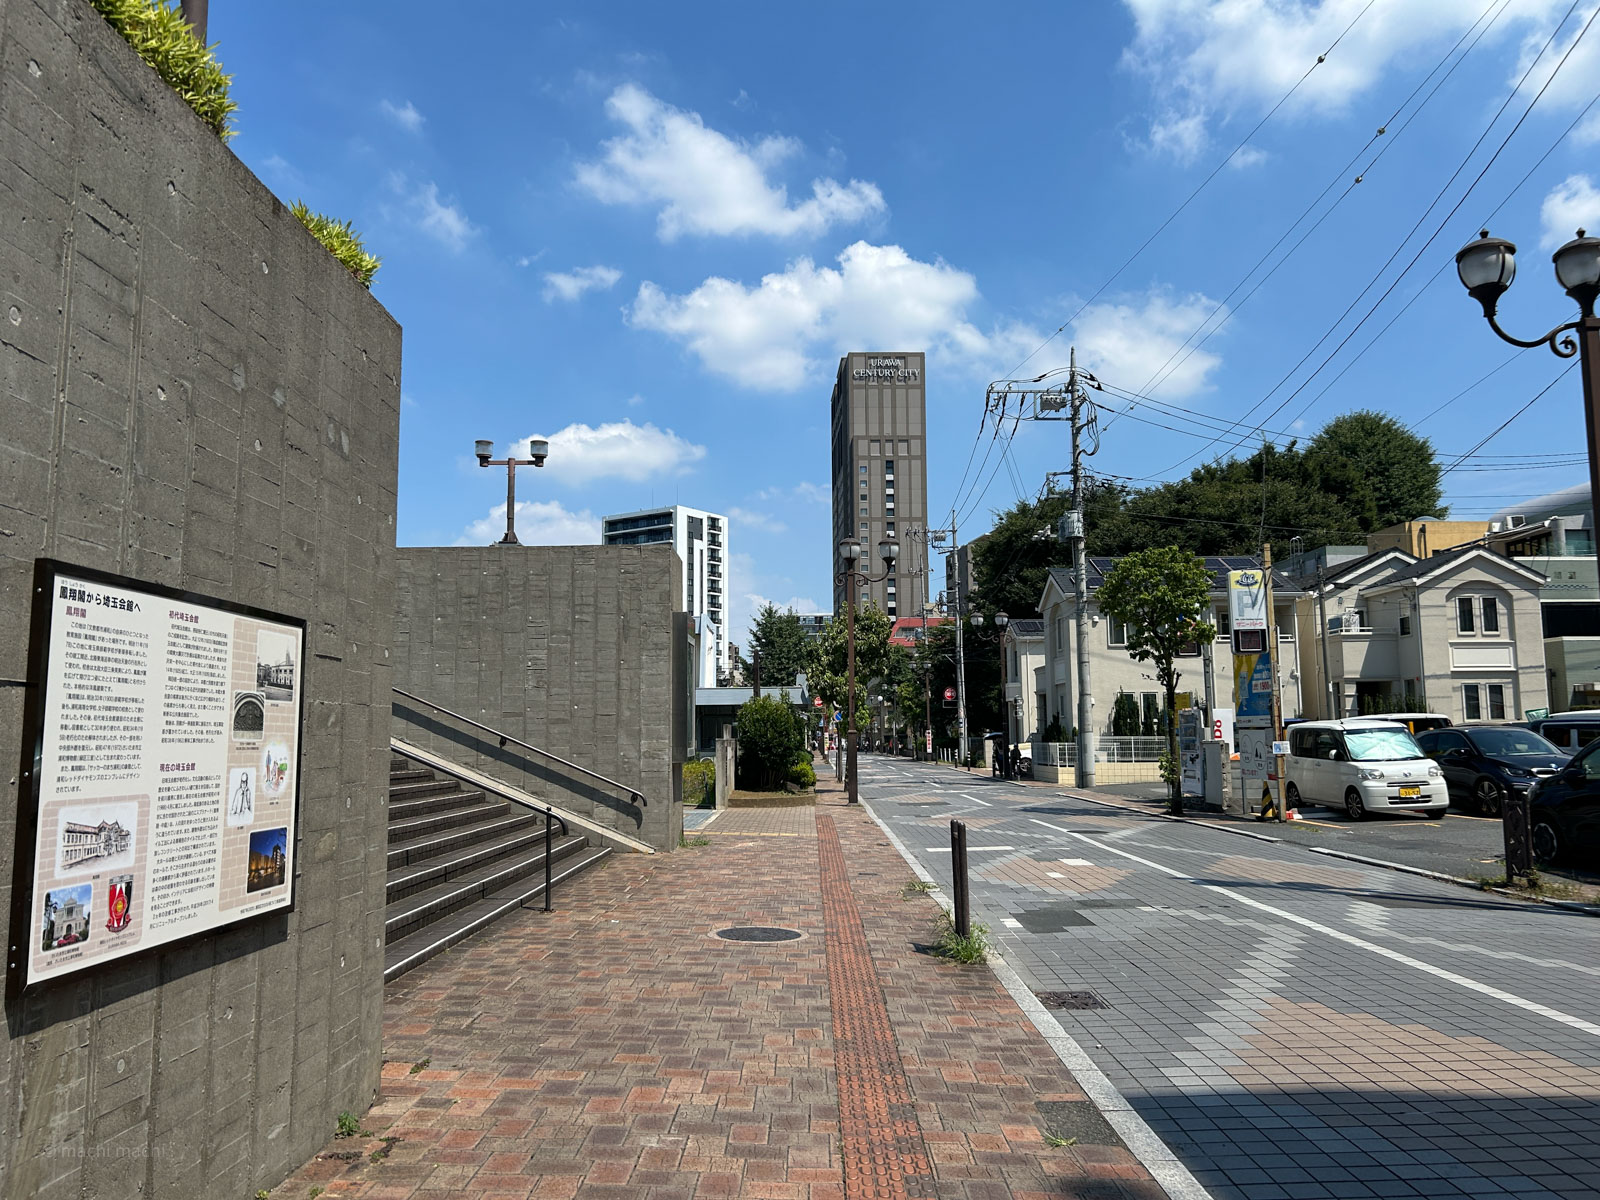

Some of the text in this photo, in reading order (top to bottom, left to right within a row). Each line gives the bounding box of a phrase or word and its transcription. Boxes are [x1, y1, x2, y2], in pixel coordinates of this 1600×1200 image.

[871, 358, 902, 366] URAWA
[853, 369, 920, 377] CENTURY CITY
[59, 585, 141, 613] 鳳翔閣から埼玉会館へ
[1237, 591, 1258, 617] P
[168, 609, 199, 623] 初代埼玉会館
[159, 762, 195, 772] 現在の埼玉会館
